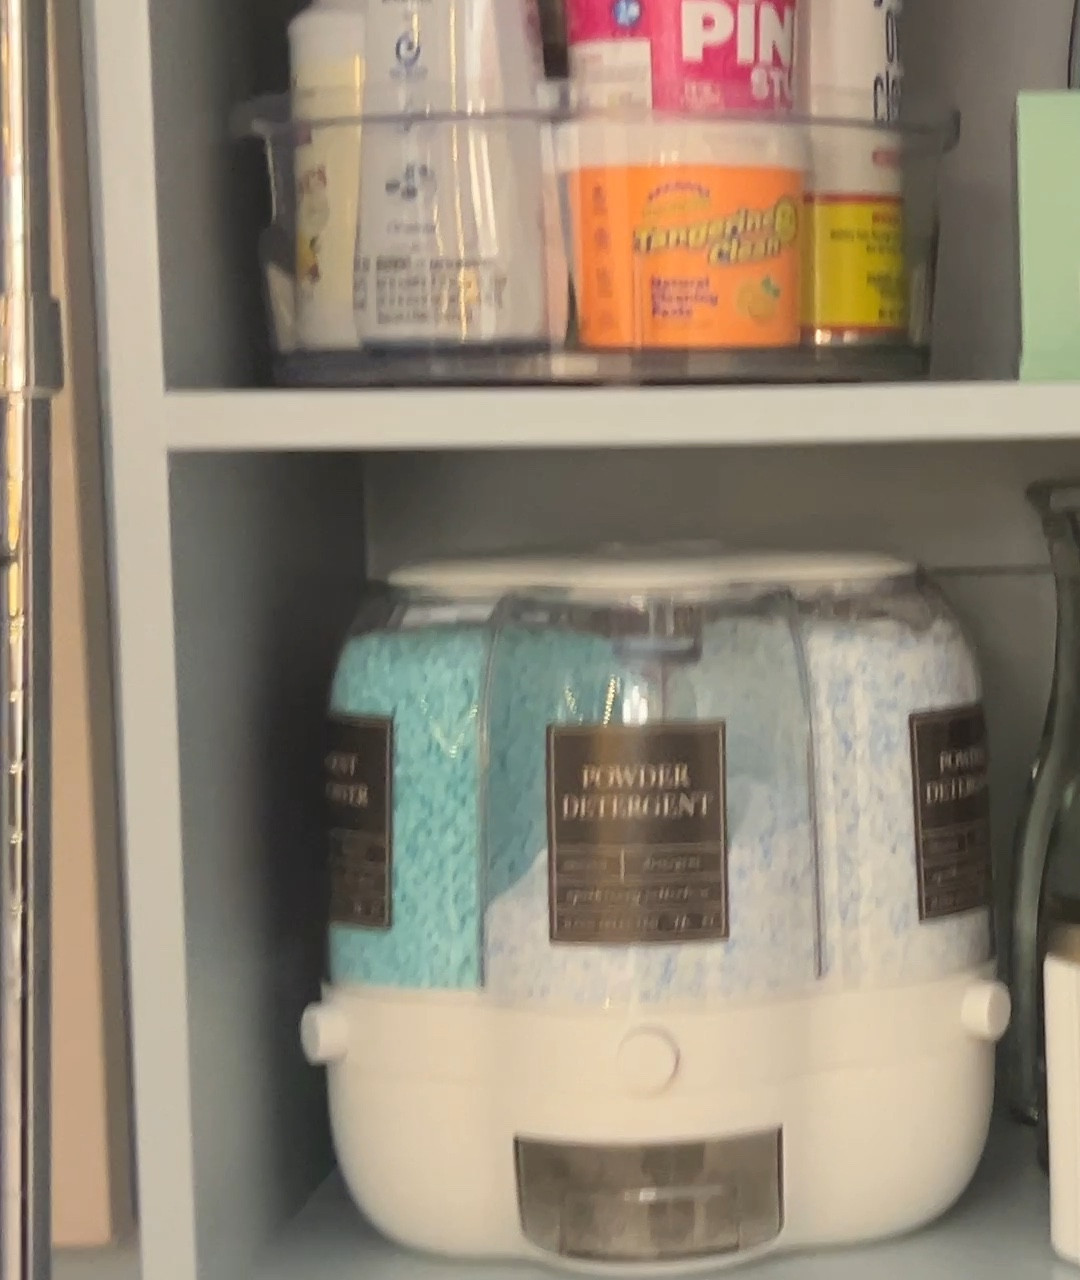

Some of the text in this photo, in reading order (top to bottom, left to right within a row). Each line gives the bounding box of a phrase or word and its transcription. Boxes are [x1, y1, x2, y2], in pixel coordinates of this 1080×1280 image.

[633, 208, 775, 257] Tangerine
[708, 236, 782, 267] Clean
[581, 762, 690, 790] POWDER
[562, 791, 716, 820] DETERGENT
